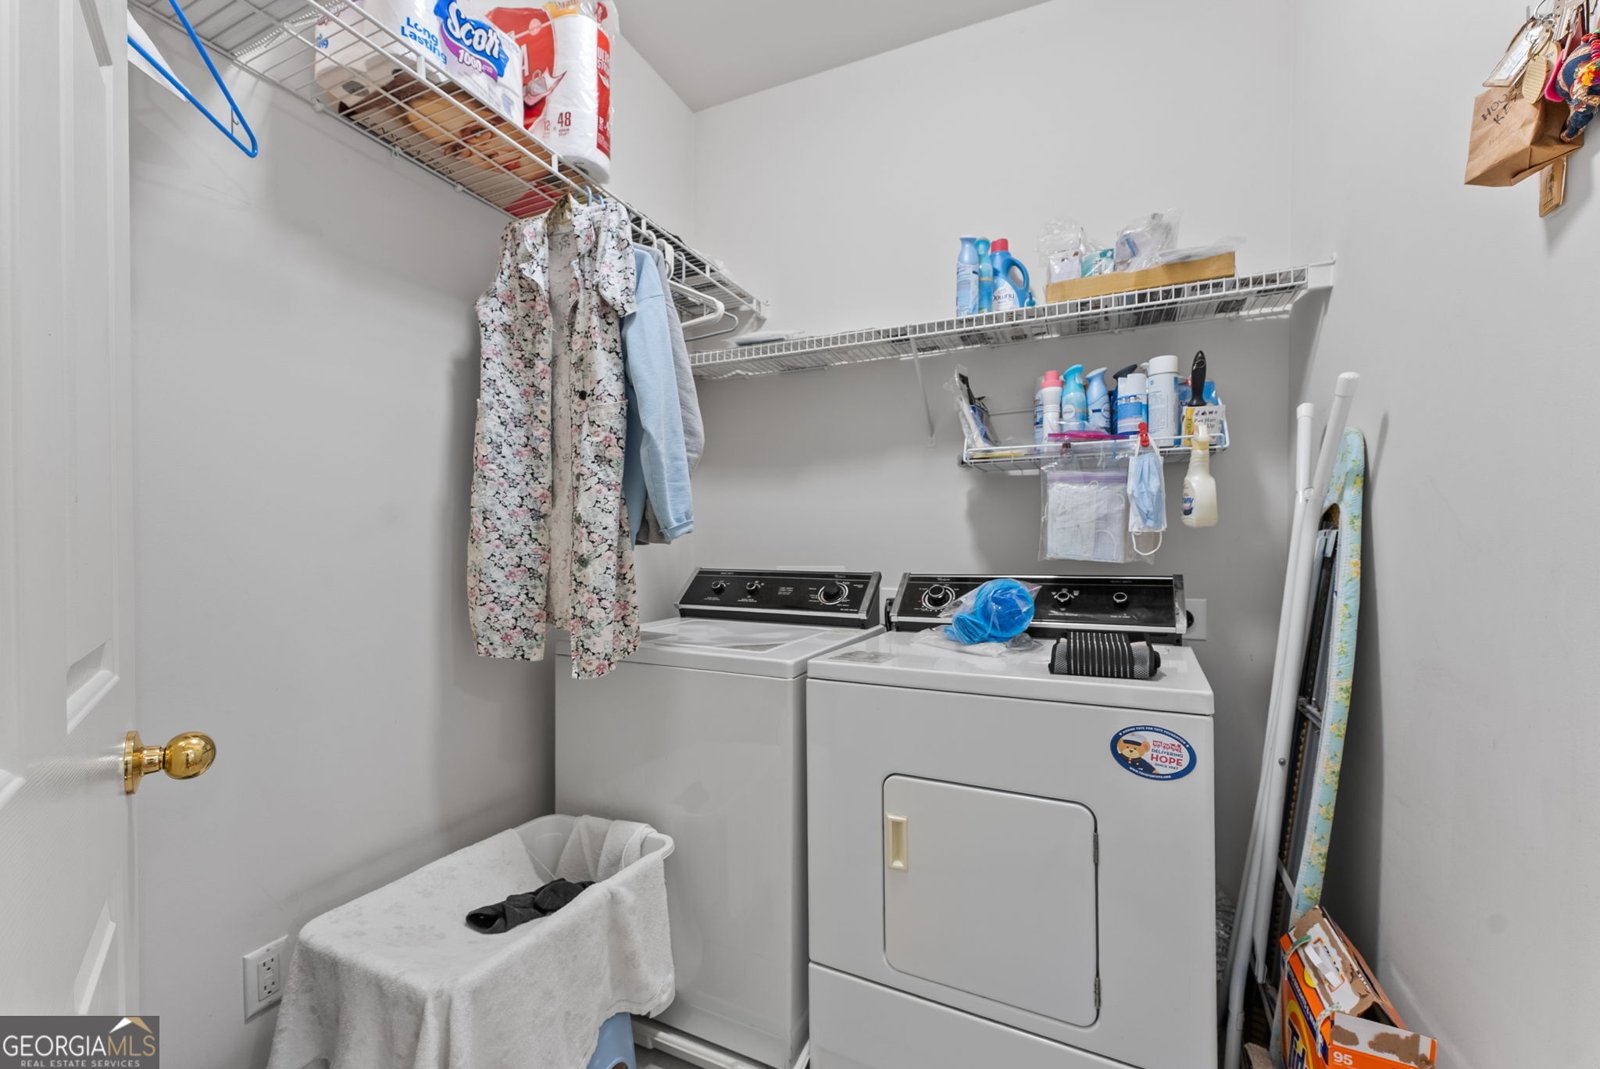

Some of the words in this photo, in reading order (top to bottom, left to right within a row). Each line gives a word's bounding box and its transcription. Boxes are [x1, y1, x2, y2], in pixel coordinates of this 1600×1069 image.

[406, 16, 439, 46] Long
[446, 1, 501, 59] Scott
[400, 25, 448, 65] Lasting
[557, 111, 572, 127] 48
[1150, 754, 1183, 767] HOPE
[1151, 748, 1184, 758] DELIVERING
[1333, 1051, 1353, 1065] 95
